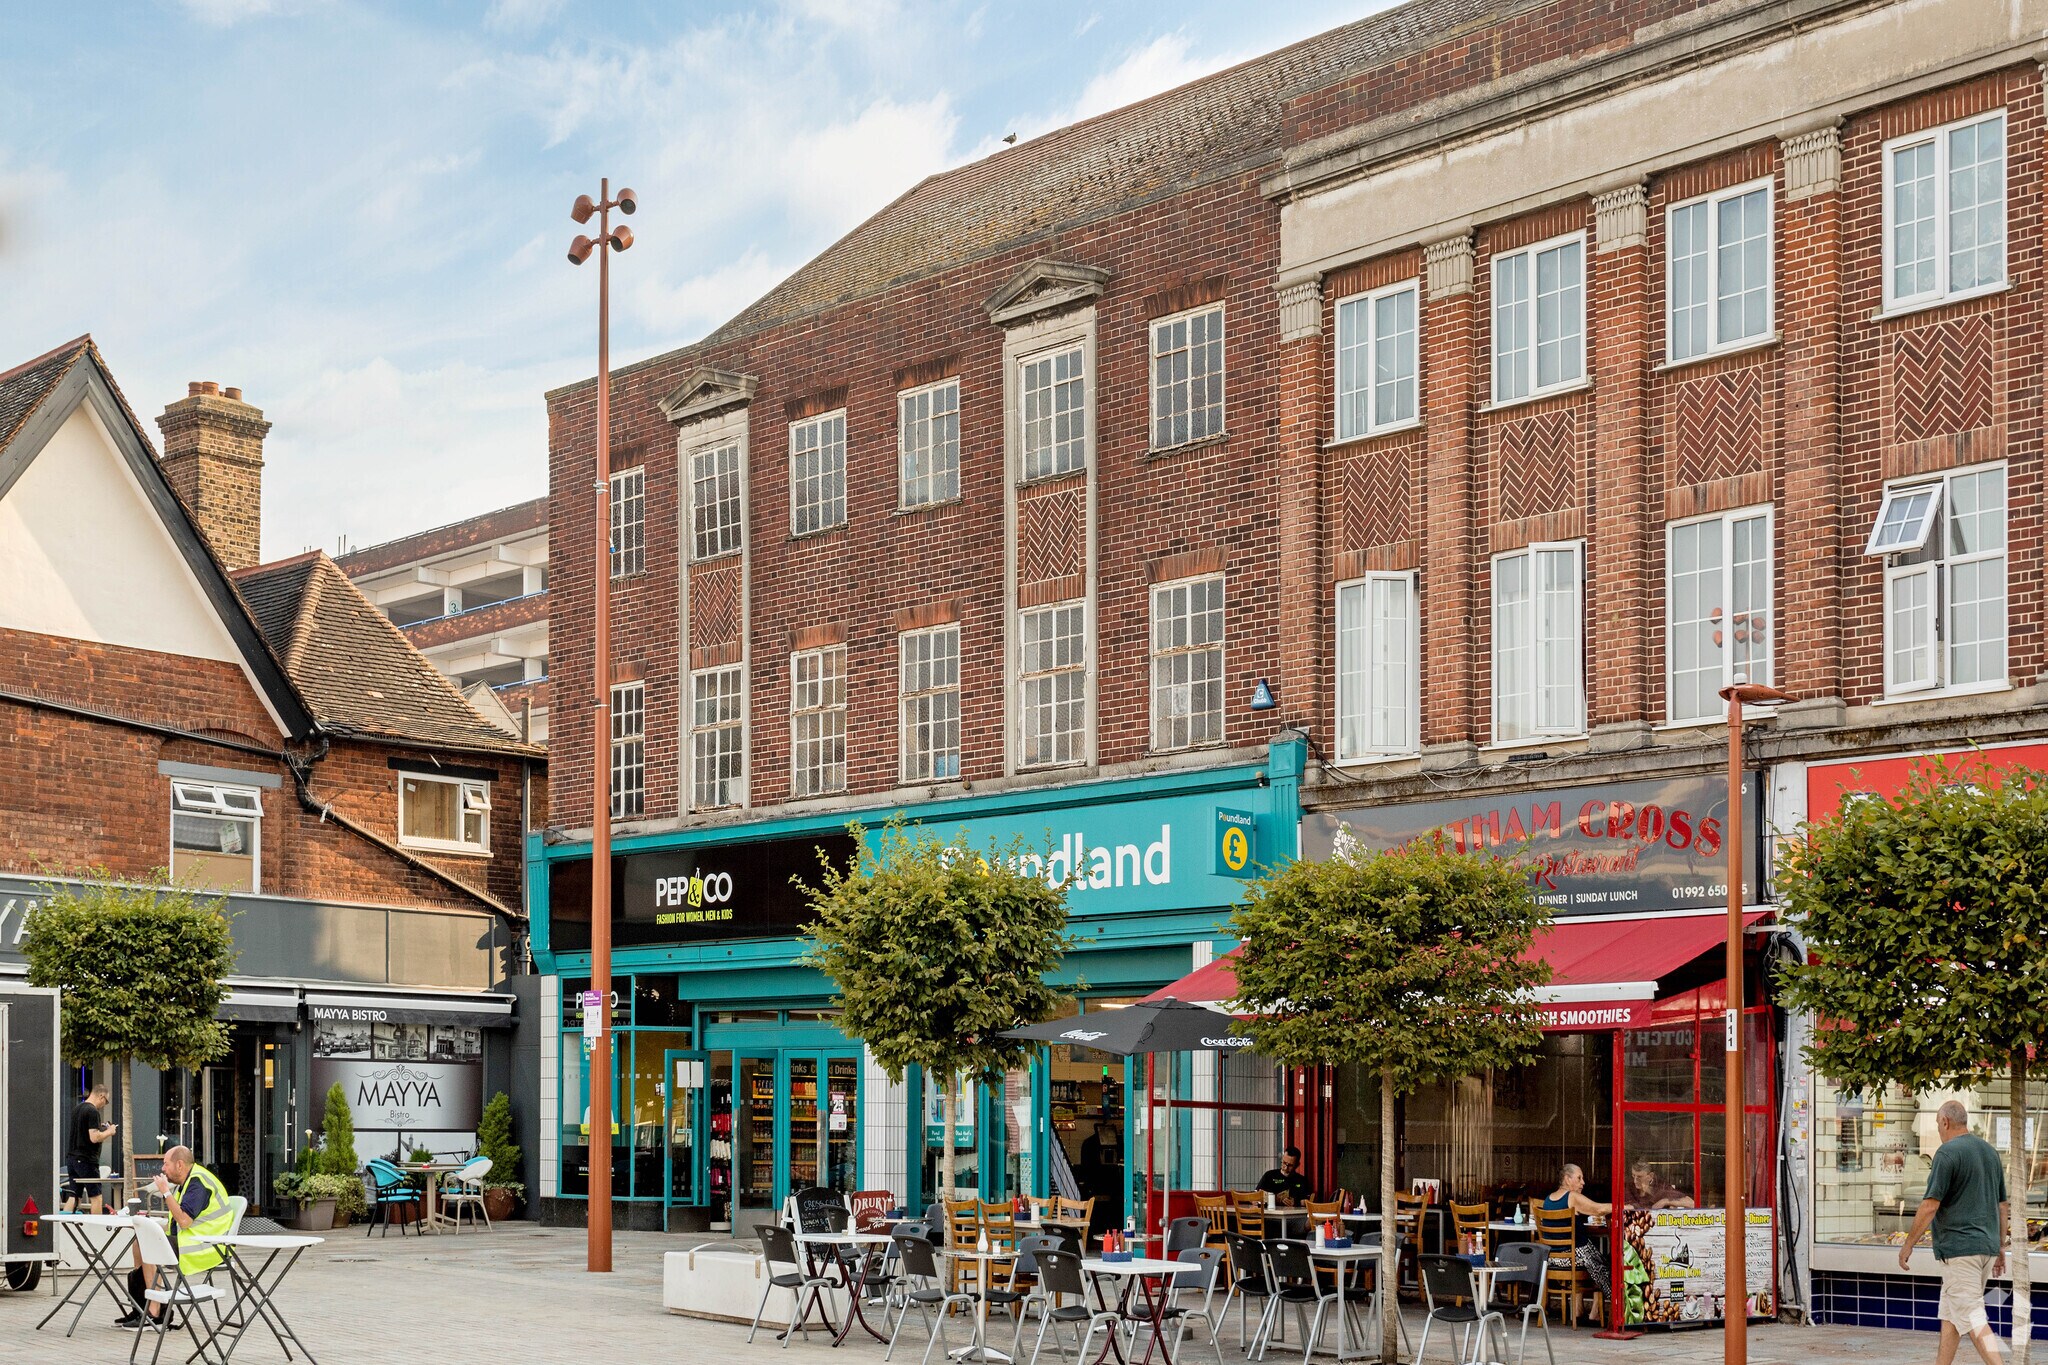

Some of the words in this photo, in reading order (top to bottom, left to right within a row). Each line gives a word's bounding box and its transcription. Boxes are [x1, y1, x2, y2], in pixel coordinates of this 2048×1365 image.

[1218, 811, 1251, 826] Poundland
[1578, 799, 1722, 858] CROSS
[1532, 844, 1646, 890] Restaurant
[656, 870, 733, 907] PEP&CO
[1672, 886, 1705, 899] 01992
[1708, 884, 1748, 898] 6505
[1538, 894, 1568, 905] DINNER
[1575, 892, 1608, 904] SUNDAY
[1609, 890, 1638, 901] LUNCH
[656, 912, 675, 925] FASHION
[676, 912, 686, 923] FOR
[705, 909, 716, 921] MEN
[721, 908, 733, 920] KIDS
[314, 1008, 350, 1020] MAYYA
[352, 1010, 387, 1021] BISTRO
[1560, 1008, 1631, 1026] SMOOTHIES
[834, 1065, 857, 1075] Drinks
[357, 1080, 442, 1108] MAYYA
[389, 1110, 410, 1119] Bistro
[853, 1197, 887, 1217] DRURY
[1657, 1213, 1668, 1226] All
[1668, 1213, 1682, 1227] Day
[1684, 1213, 1714, 1226] Breakfast
[1749, 1212, 1771, 1225] Dinner
[1659, 1267, 1686, 1279] Waltham
